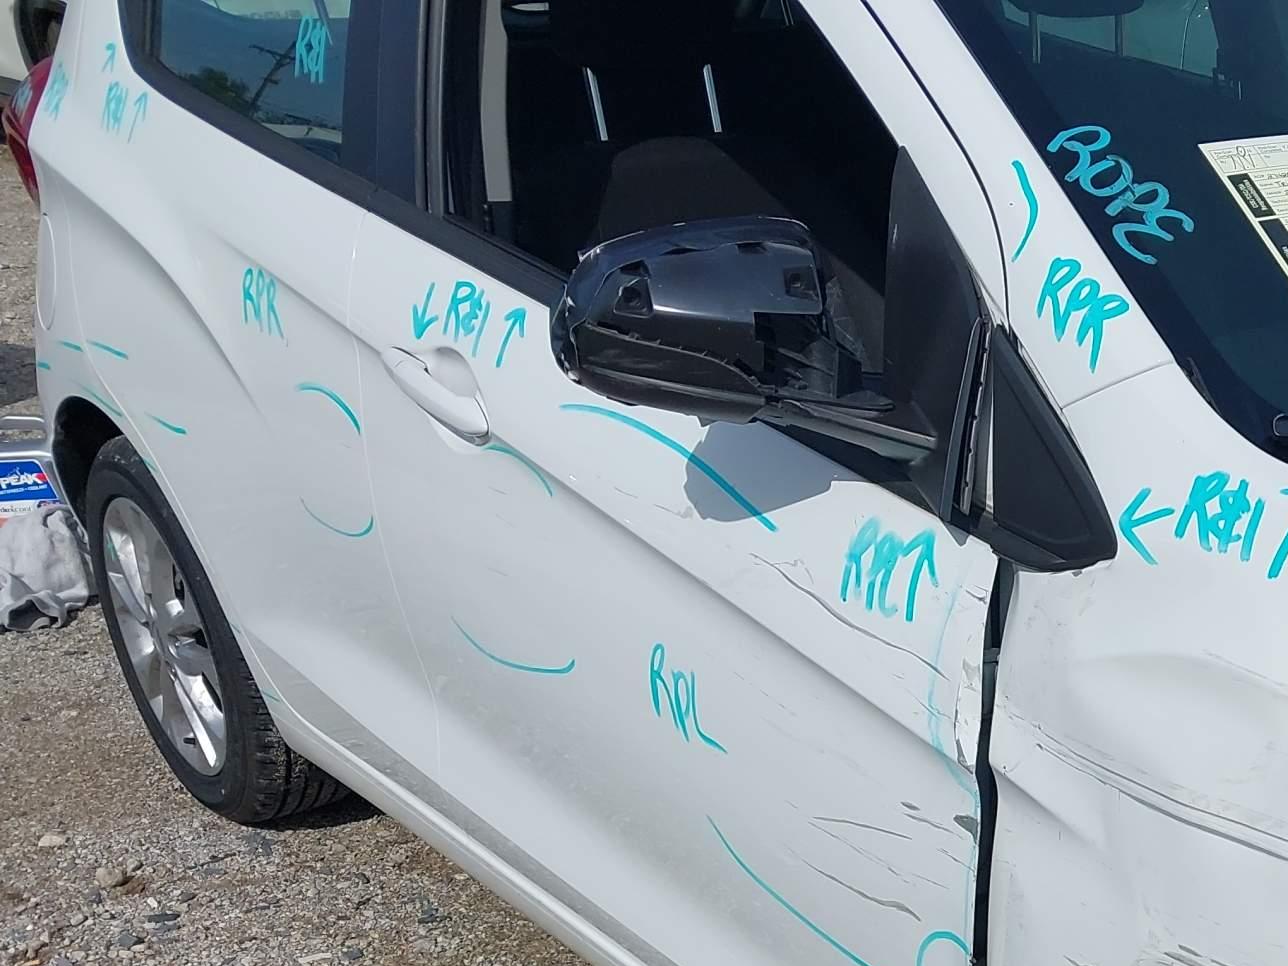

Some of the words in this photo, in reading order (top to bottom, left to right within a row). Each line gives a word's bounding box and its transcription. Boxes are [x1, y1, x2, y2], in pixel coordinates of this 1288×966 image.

[242, 267, 285, 341] RPR
[1036, 257, 1130, 374] RPR
[0, 471, 44, 489] PEAK
[649, 643, 728, 753] RPL
